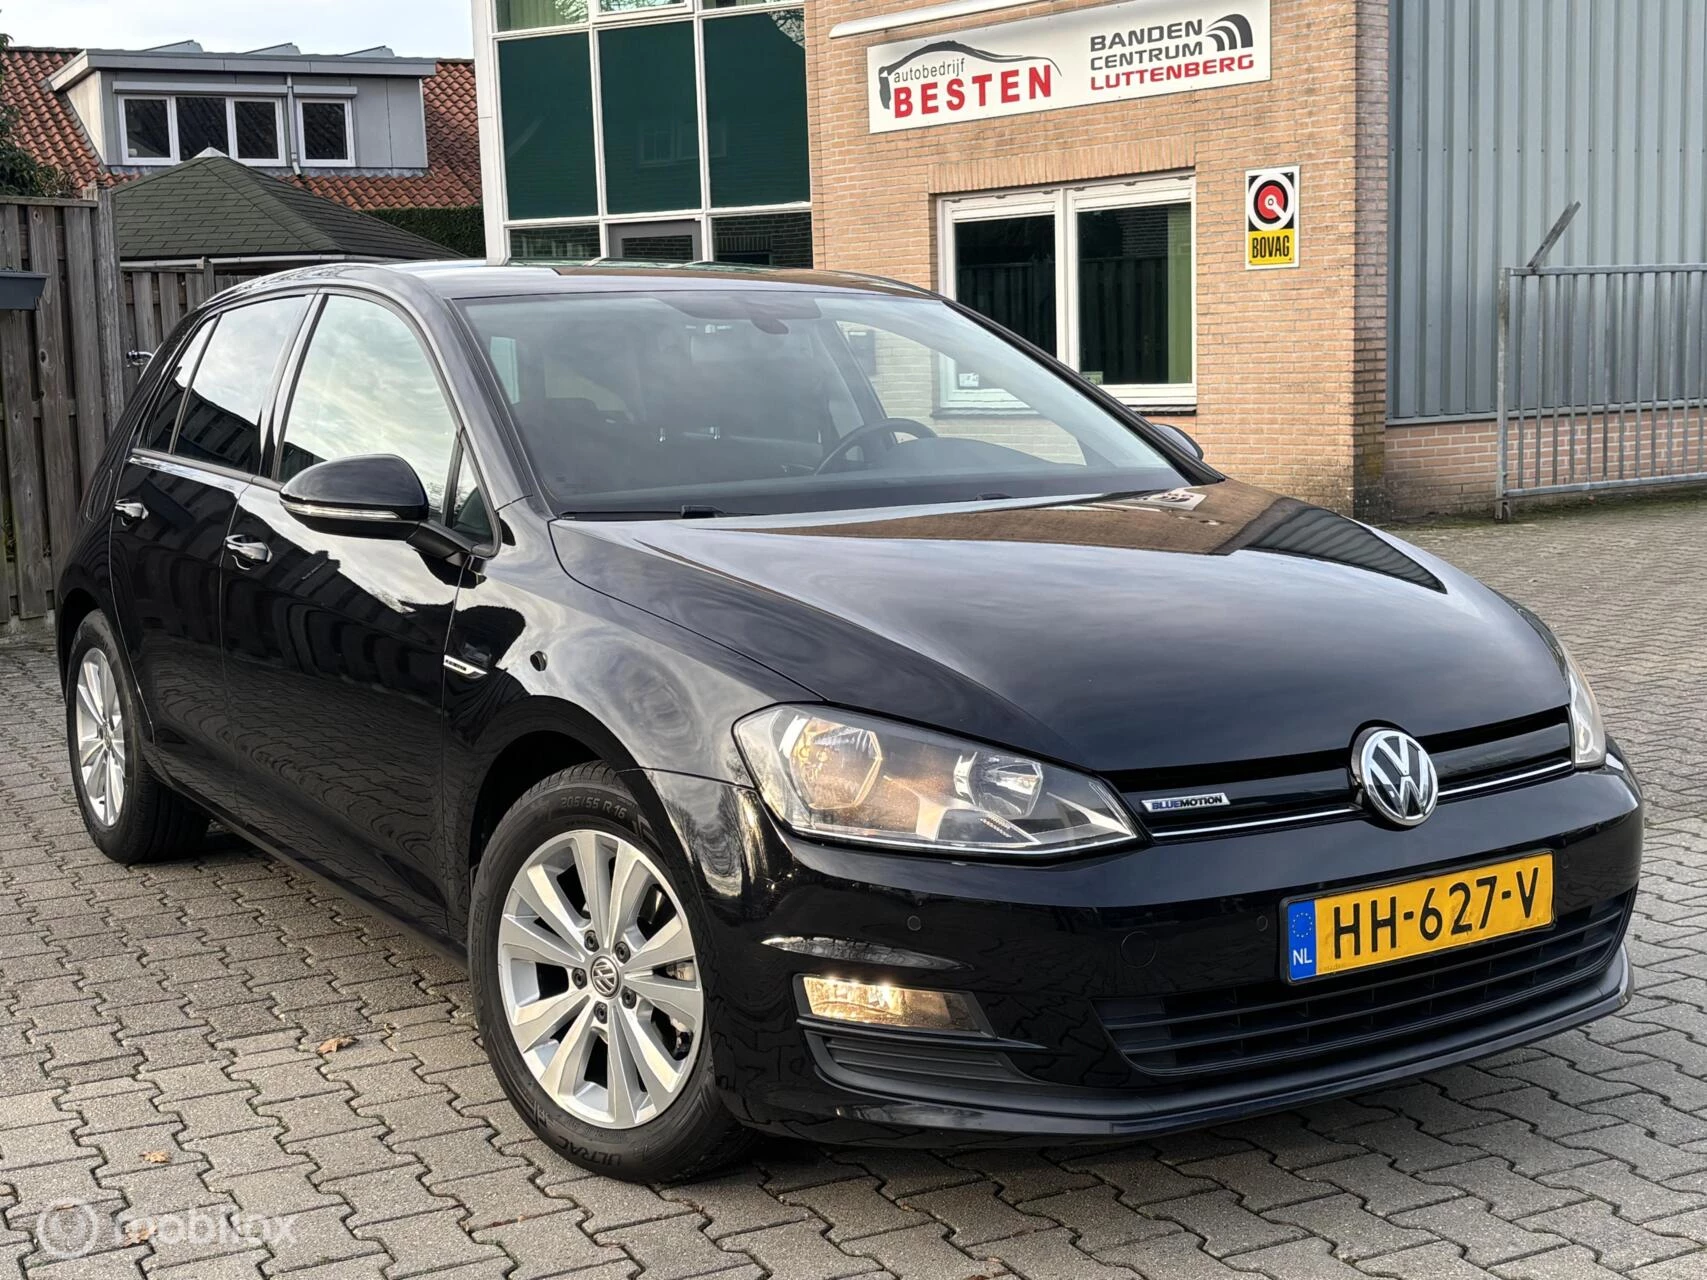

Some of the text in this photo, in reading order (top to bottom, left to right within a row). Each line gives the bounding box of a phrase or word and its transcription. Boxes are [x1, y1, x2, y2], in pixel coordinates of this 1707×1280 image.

[1090, 18, 1203, 52] BANDEN
[893, 57, 966, 84] autobedrijf
[1090, 40, 1203, 71] CENTRUM
[1090, 53, 1254, 91] LUTTENBERG
[894, 64, 1052, 118] BESTEN
[1251, 235, 1290, 258] BOVAG
[561, 795, 628, 819] 205/55 R 16
[1151, 795, 1223, 810] BLUEMOTION
[1333, 867, 1539, 960] HH-627-V
[1292, 948, 1312, 966] NL
[556, 1135, 622, 1167] ULTRAC
